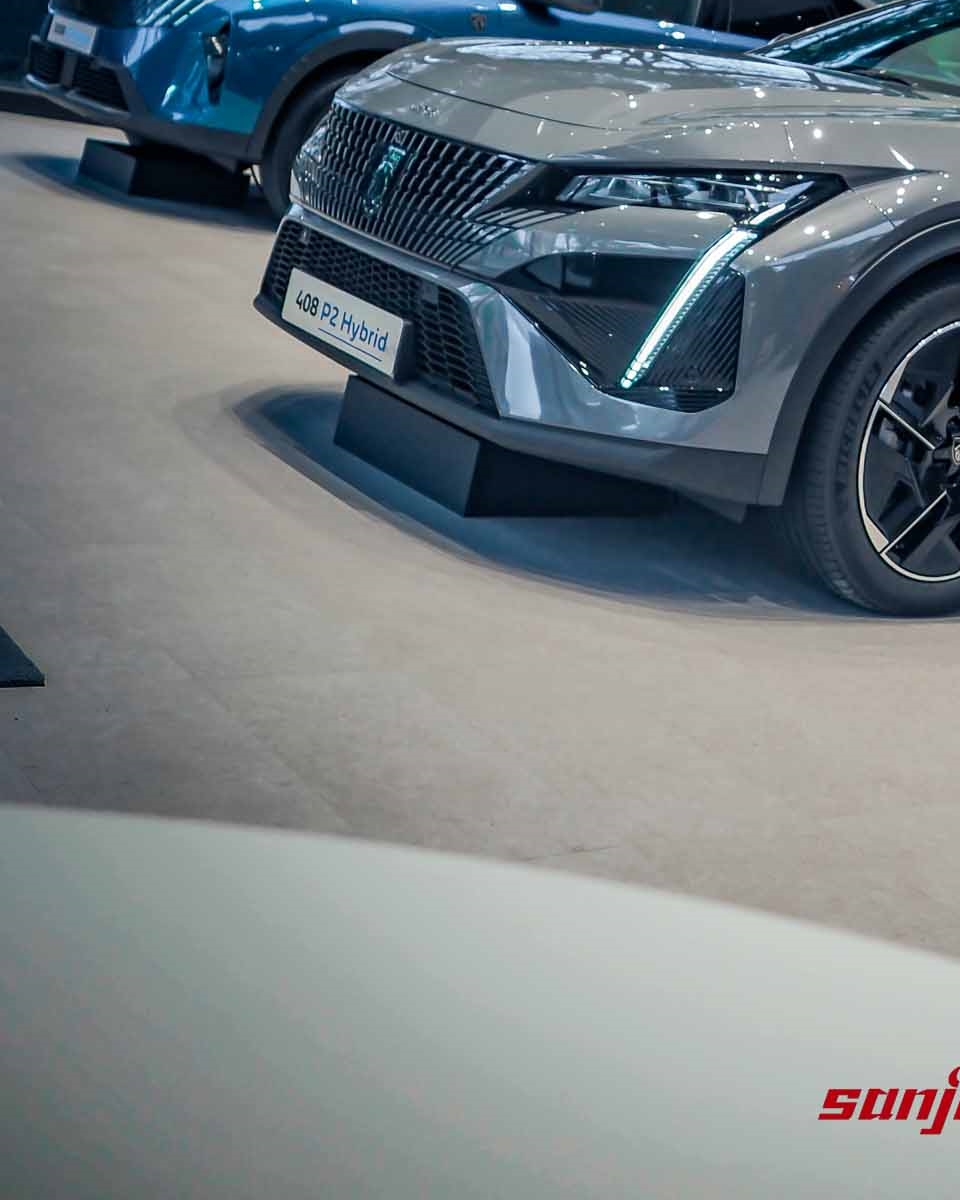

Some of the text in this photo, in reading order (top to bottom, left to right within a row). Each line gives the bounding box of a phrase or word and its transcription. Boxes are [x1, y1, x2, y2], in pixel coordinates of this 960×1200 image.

[296, 290, 389, 352] 408 P2 Hybrid
